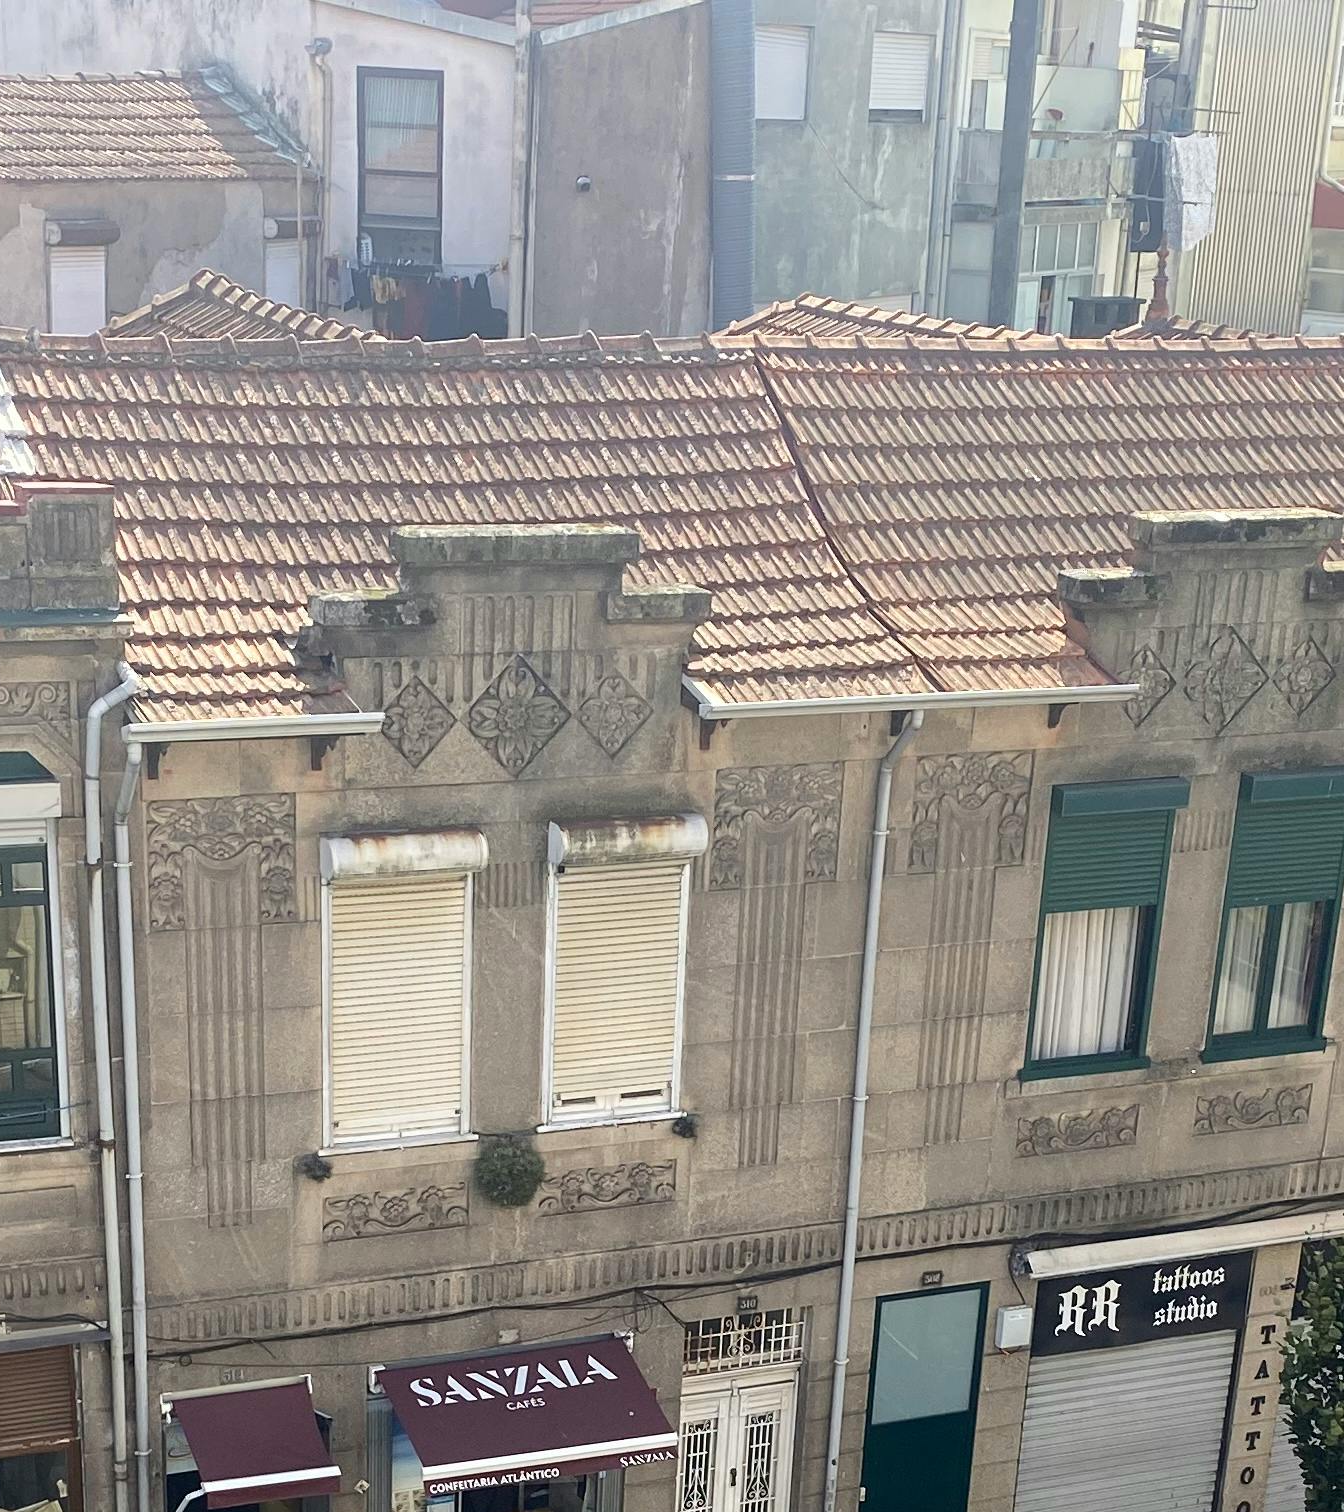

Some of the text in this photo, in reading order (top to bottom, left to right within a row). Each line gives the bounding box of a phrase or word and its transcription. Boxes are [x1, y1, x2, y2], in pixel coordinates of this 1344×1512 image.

[1152, 1264, 1226, 1295] tattoos
[1152, 1295, 1218, 1327] studio
[506, 1397, 546, 1411] CAFÉS
[429, 1467, 560, 1494] CONFEITARIA ATLÂNTICO
